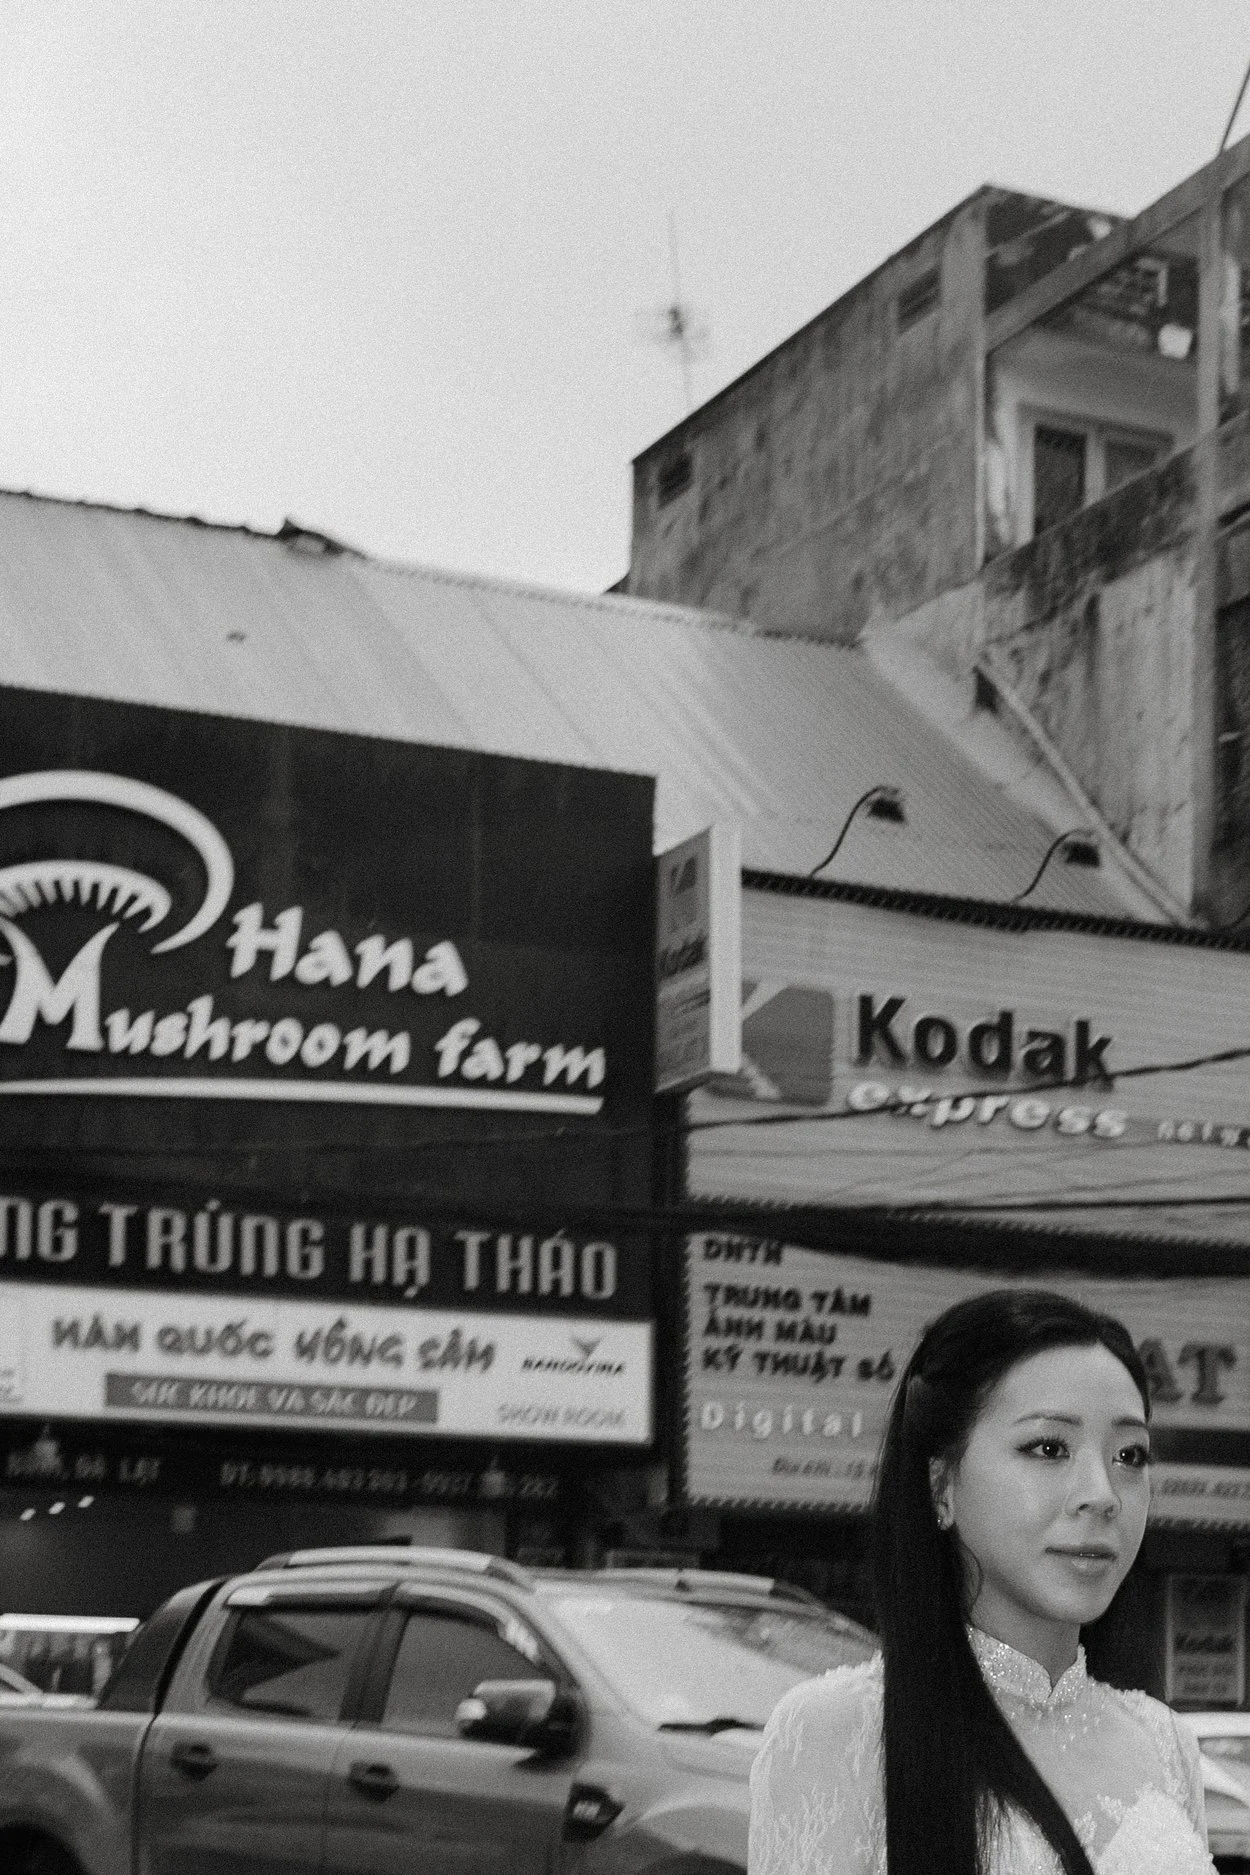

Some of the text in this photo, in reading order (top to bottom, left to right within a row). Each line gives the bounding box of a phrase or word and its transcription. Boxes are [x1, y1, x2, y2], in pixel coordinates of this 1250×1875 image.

[227, 901, 469, 997] Hana
[0, 916, 607, 1089] Mushroom farm
[852, 991, 1115, 1091] Kodak
[848, 1076, 1130, 1140] express
[349, 1222, 432, 1300] HẠ
[702, 1280, 873, 1318] TRUNG TÂM
[774, 1316, 838, 1346] MÀU
[752, 1347, 847, 1384] THUẬT
[701, 1400, 863, 1439] Digital
